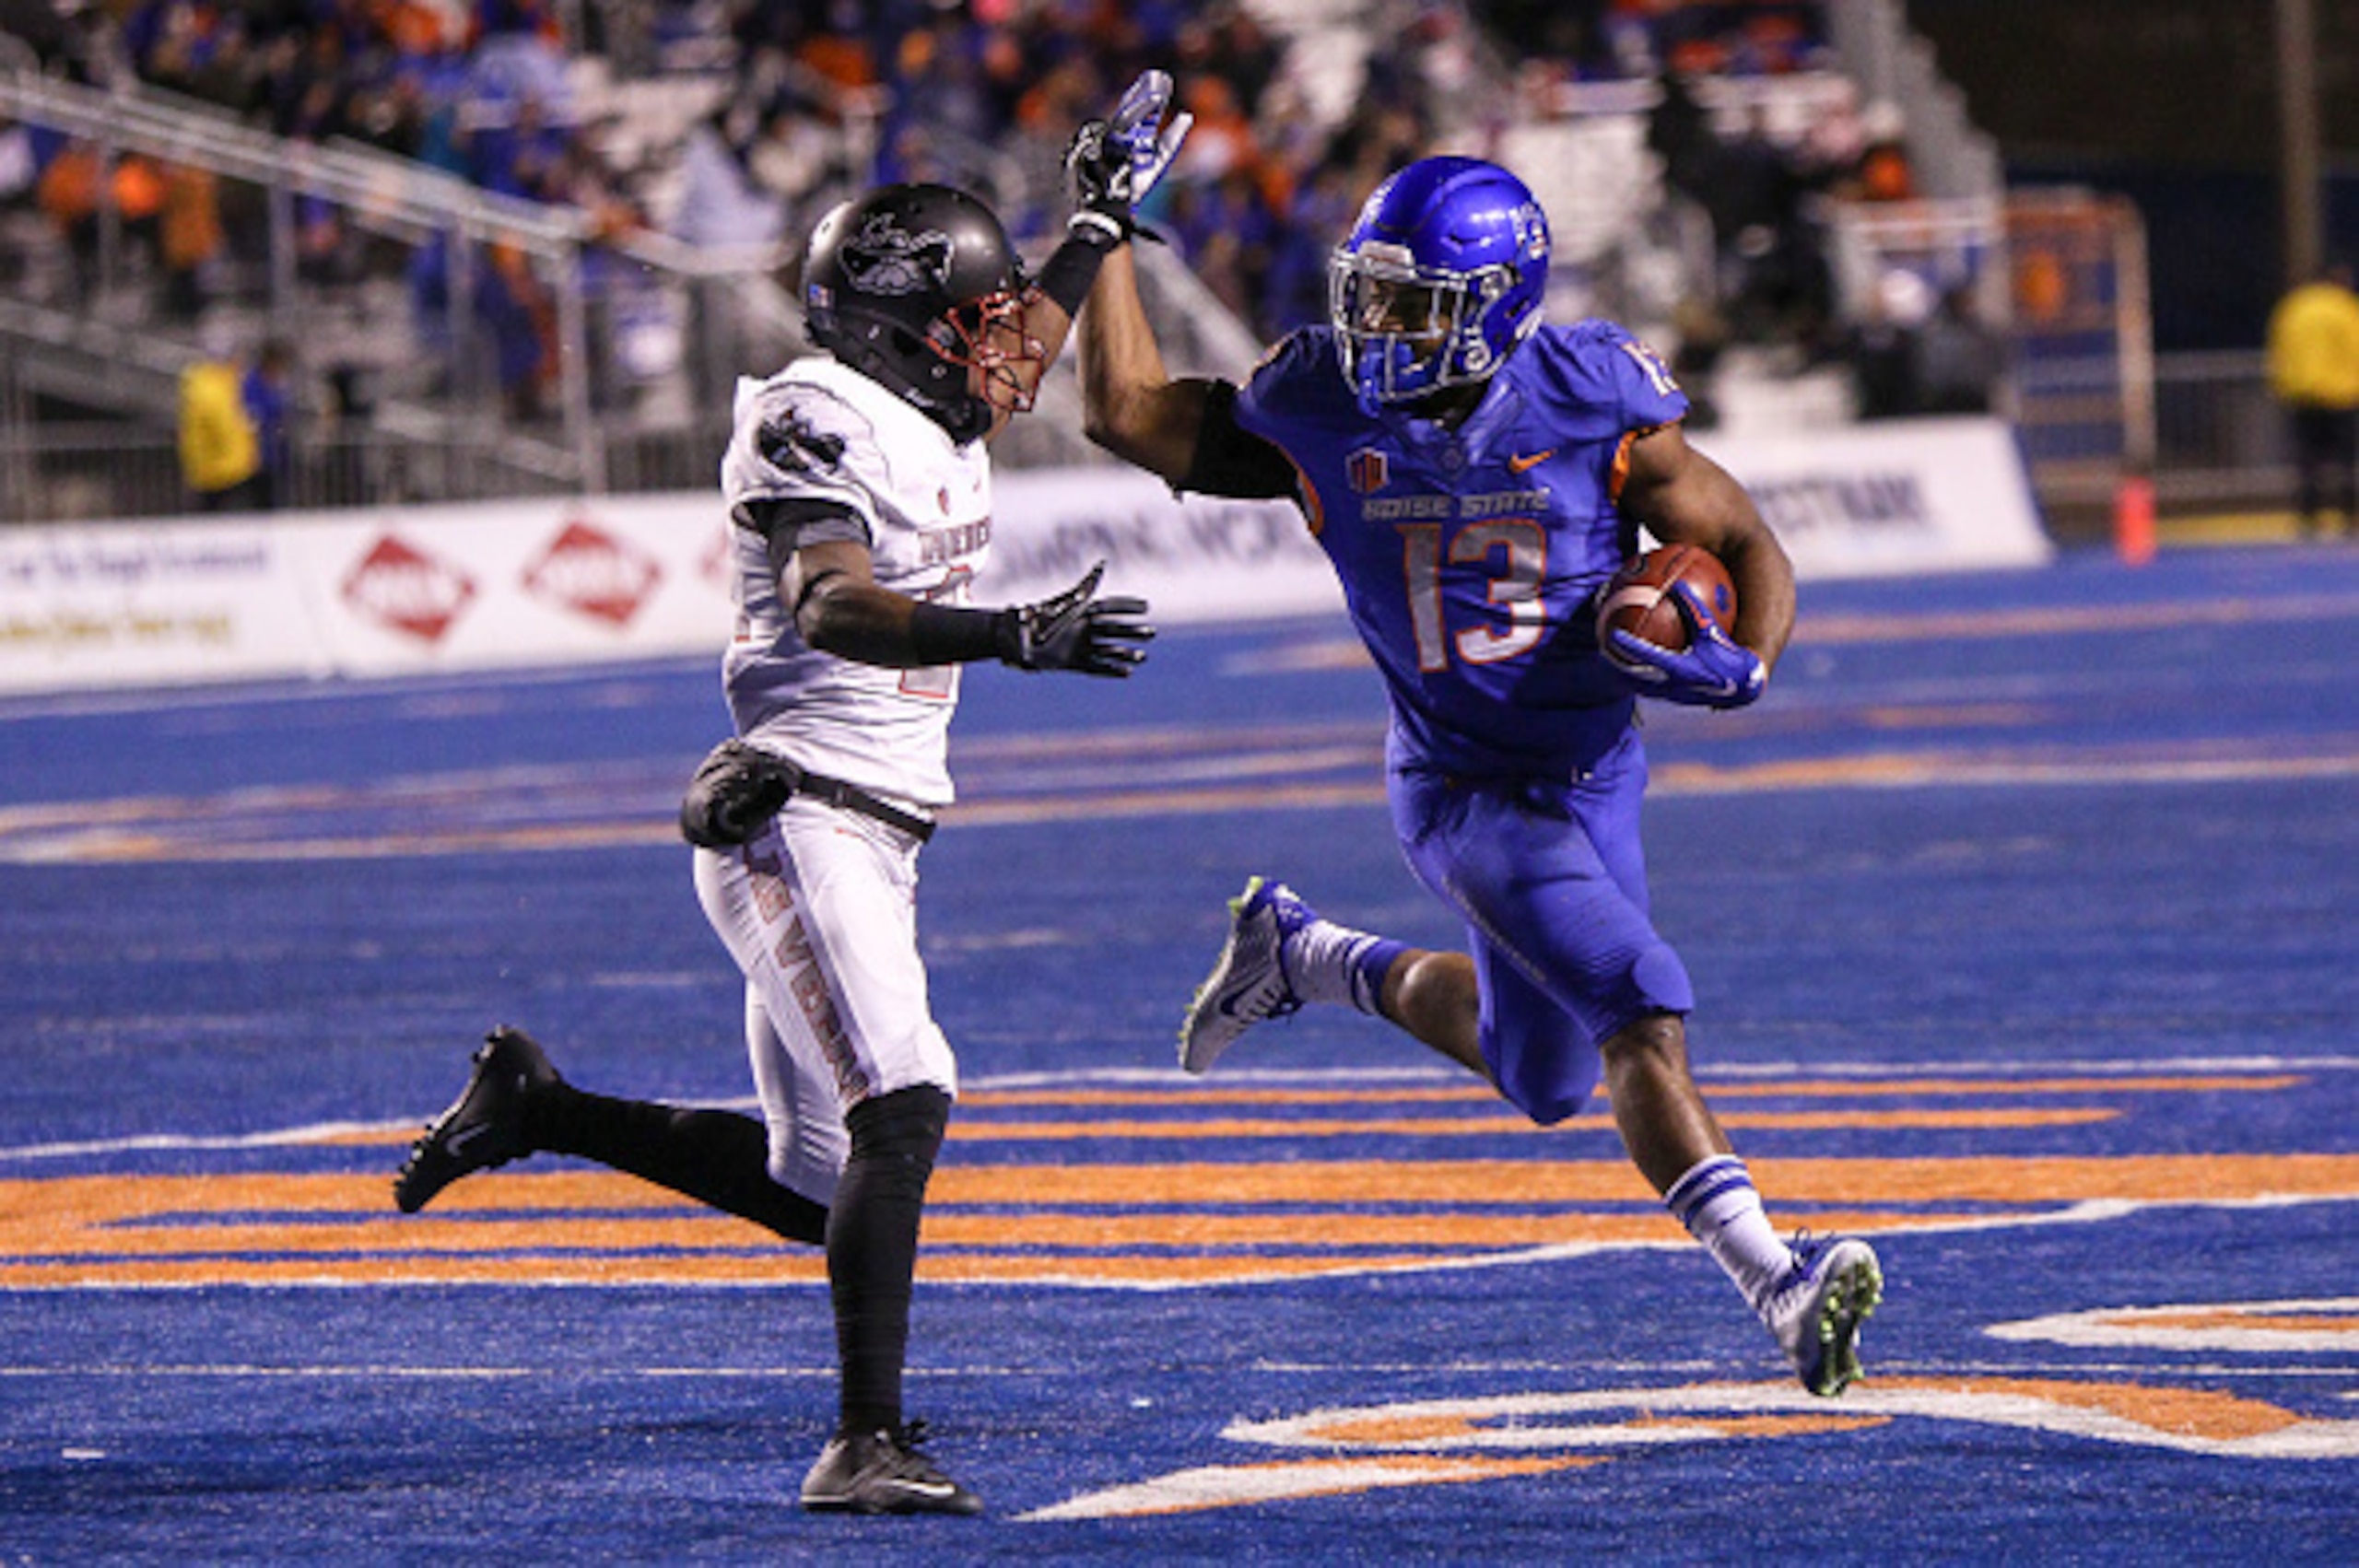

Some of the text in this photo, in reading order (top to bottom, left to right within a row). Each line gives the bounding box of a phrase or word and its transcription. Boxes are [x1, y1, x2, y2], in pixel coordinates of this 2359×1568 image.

[1362, 486, 1552, 521] BOISE STATE
[1392, 518, 1547, 673] 13
